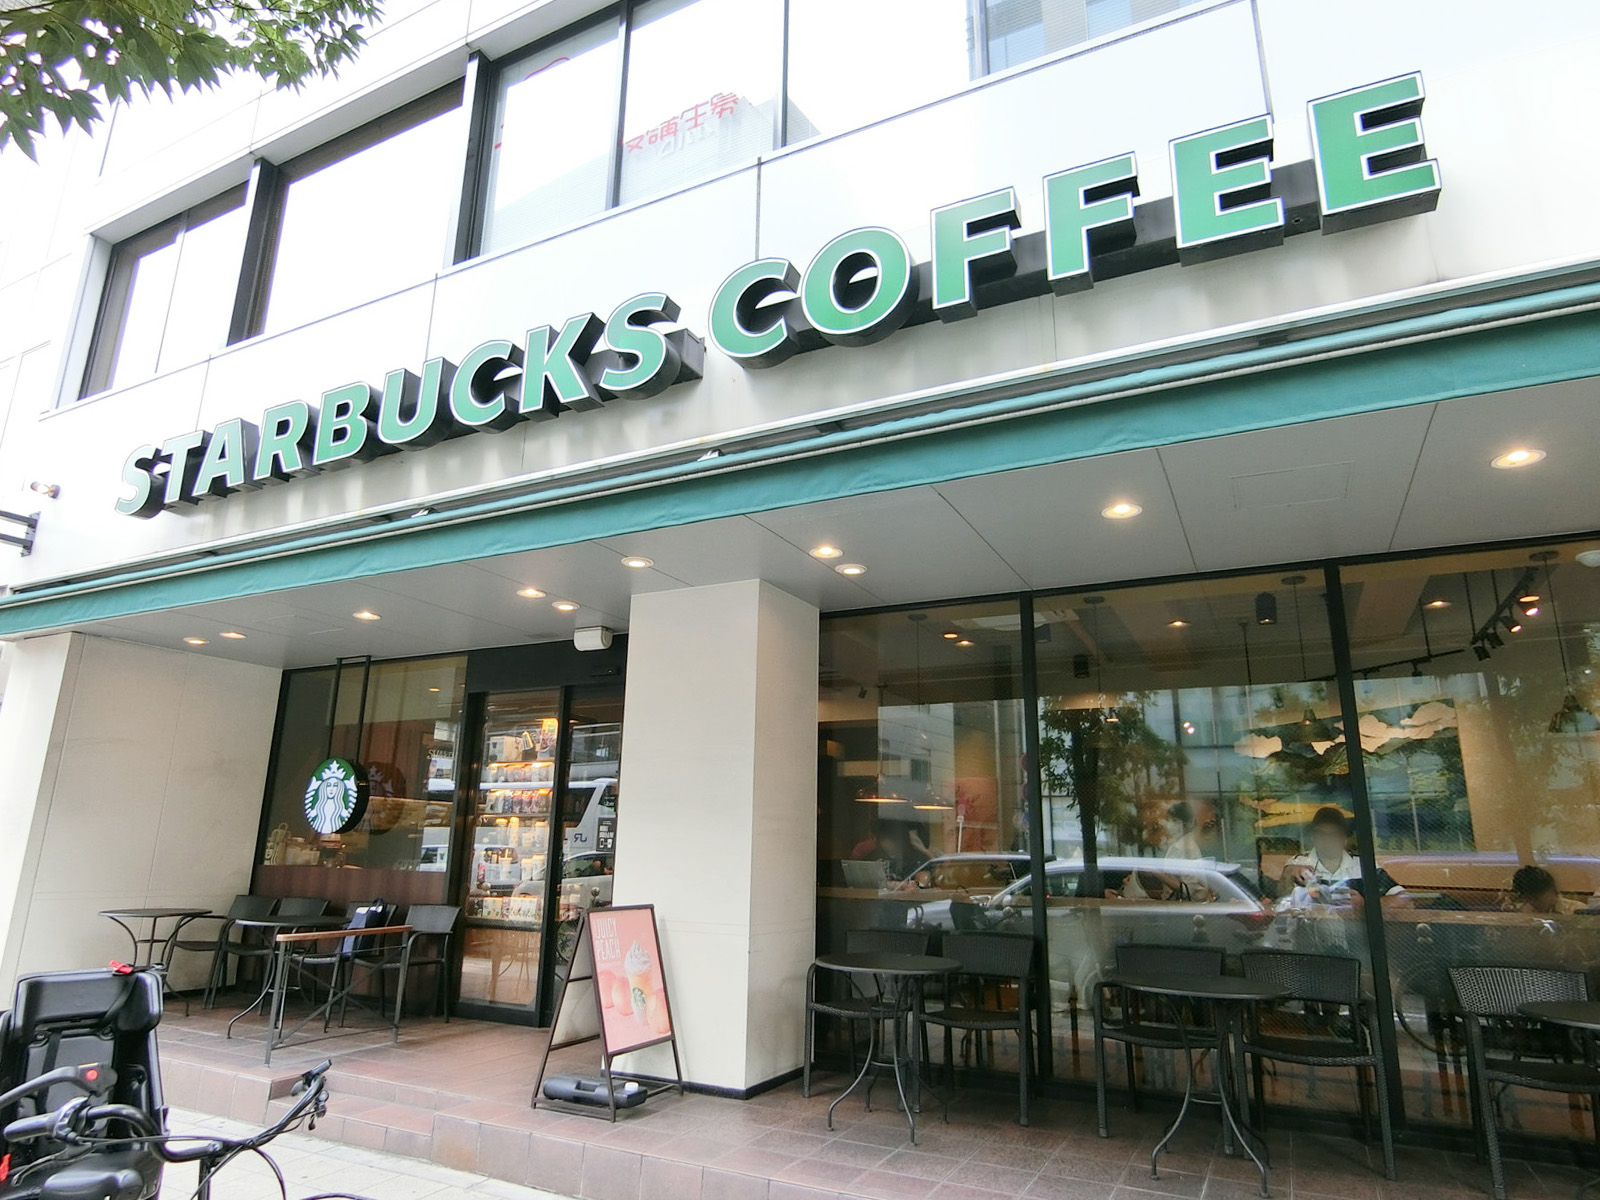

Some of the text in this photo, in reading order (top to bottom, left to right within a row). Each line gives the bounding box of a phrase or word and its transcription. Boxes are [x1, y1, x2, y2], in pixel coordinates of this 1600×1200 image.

[114, 70, 1442, 517] STARBUCKS COFFEE
[595, 917, 617, 938] JUICY
[596, 938, 621, 960] PEACH
